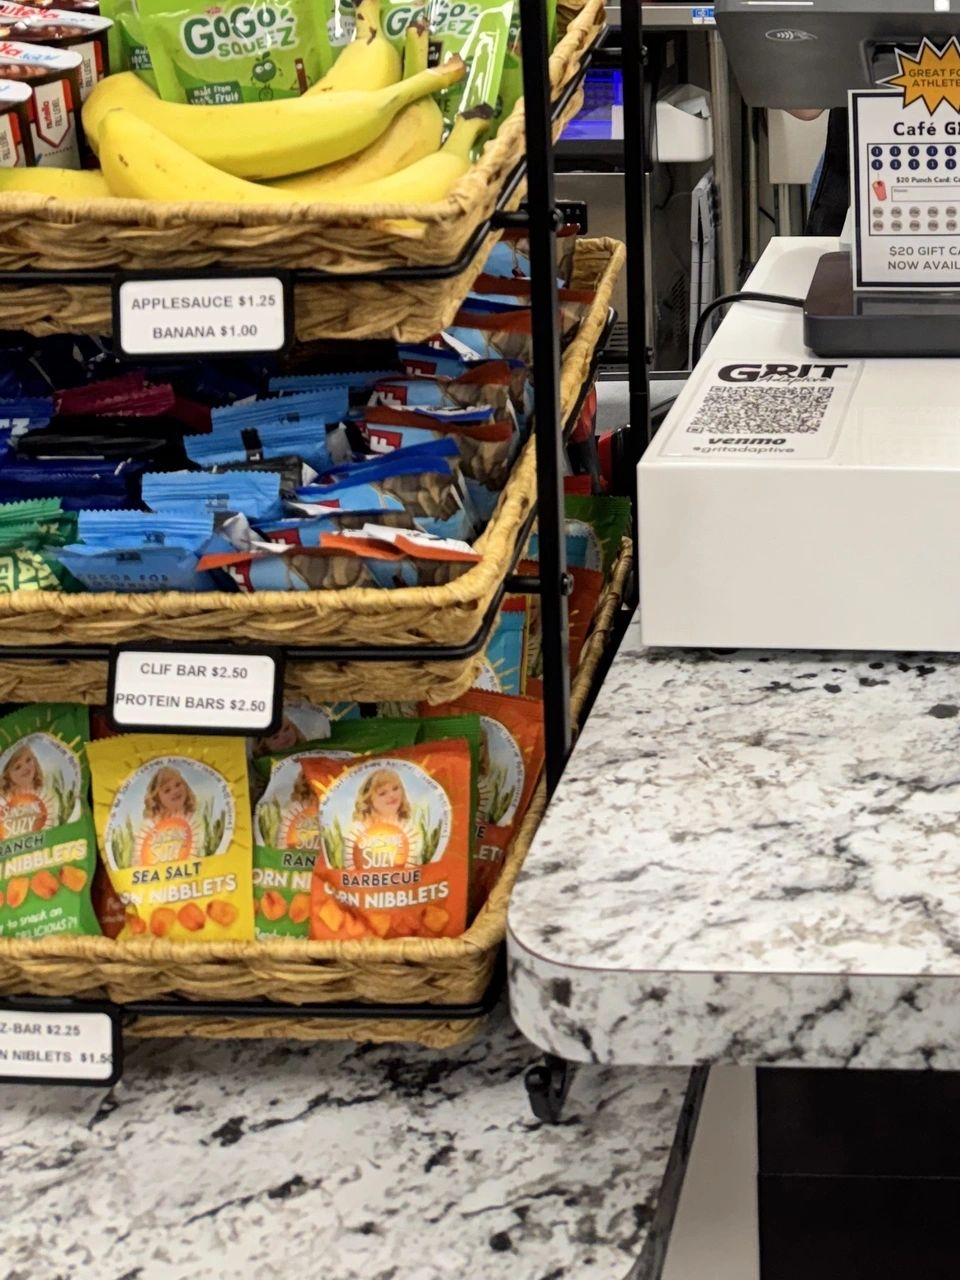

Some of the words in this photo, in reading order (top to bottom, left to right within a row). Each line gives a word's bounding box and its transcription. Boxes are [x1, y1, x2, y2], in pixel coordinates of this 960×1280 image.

[909, 68, 945, 78] GREAT
[893, 121, 937, 136] Café
[896, 176, 909, 184] $20
[911, 176, 932, 184] Punch
[889, 245, 914, 256] $20
[918, 246, 945, 256] GIFT
[887, 261, 919, 270] NOW
[131, 296, 234, 310] APPLESAUCE
[238, 294, 276, 307] $1.25
[152, 326, 215, 339] BANANA
[220, 324, 258, 337] $1.00
[717, 363, 849, 382] GRIT
[758, 372, 828, 385] Adaptive
[707, 437, 787, 445] venmo
[140, 662, 172, 675] CLIF
[176, 664, 207, 677] BAR
[211, 666, 248, 679] $2.50
[115, 692, 181, 708] PROTEIN
[185, 696, 225, 710] BARS
[230, 699, 266, 713] $2.50
[5, 839, 88, 879] NIBBLETS
[283, 853, 316, 867] RAN
[362, 848, 397, 869] SUZY
[132, 869, 161, 884] SEA
[165, 861, 203, 878] SALT
[342, 869, 421, 886] BARBECUE
[150, 873, 237, 905] NIBBLETS
[364, 881, 449, 909] NIBBLETS
[46, 1024, 81, 1036] $2.25
[12, 1049, 73, 1063] NIBLETS
